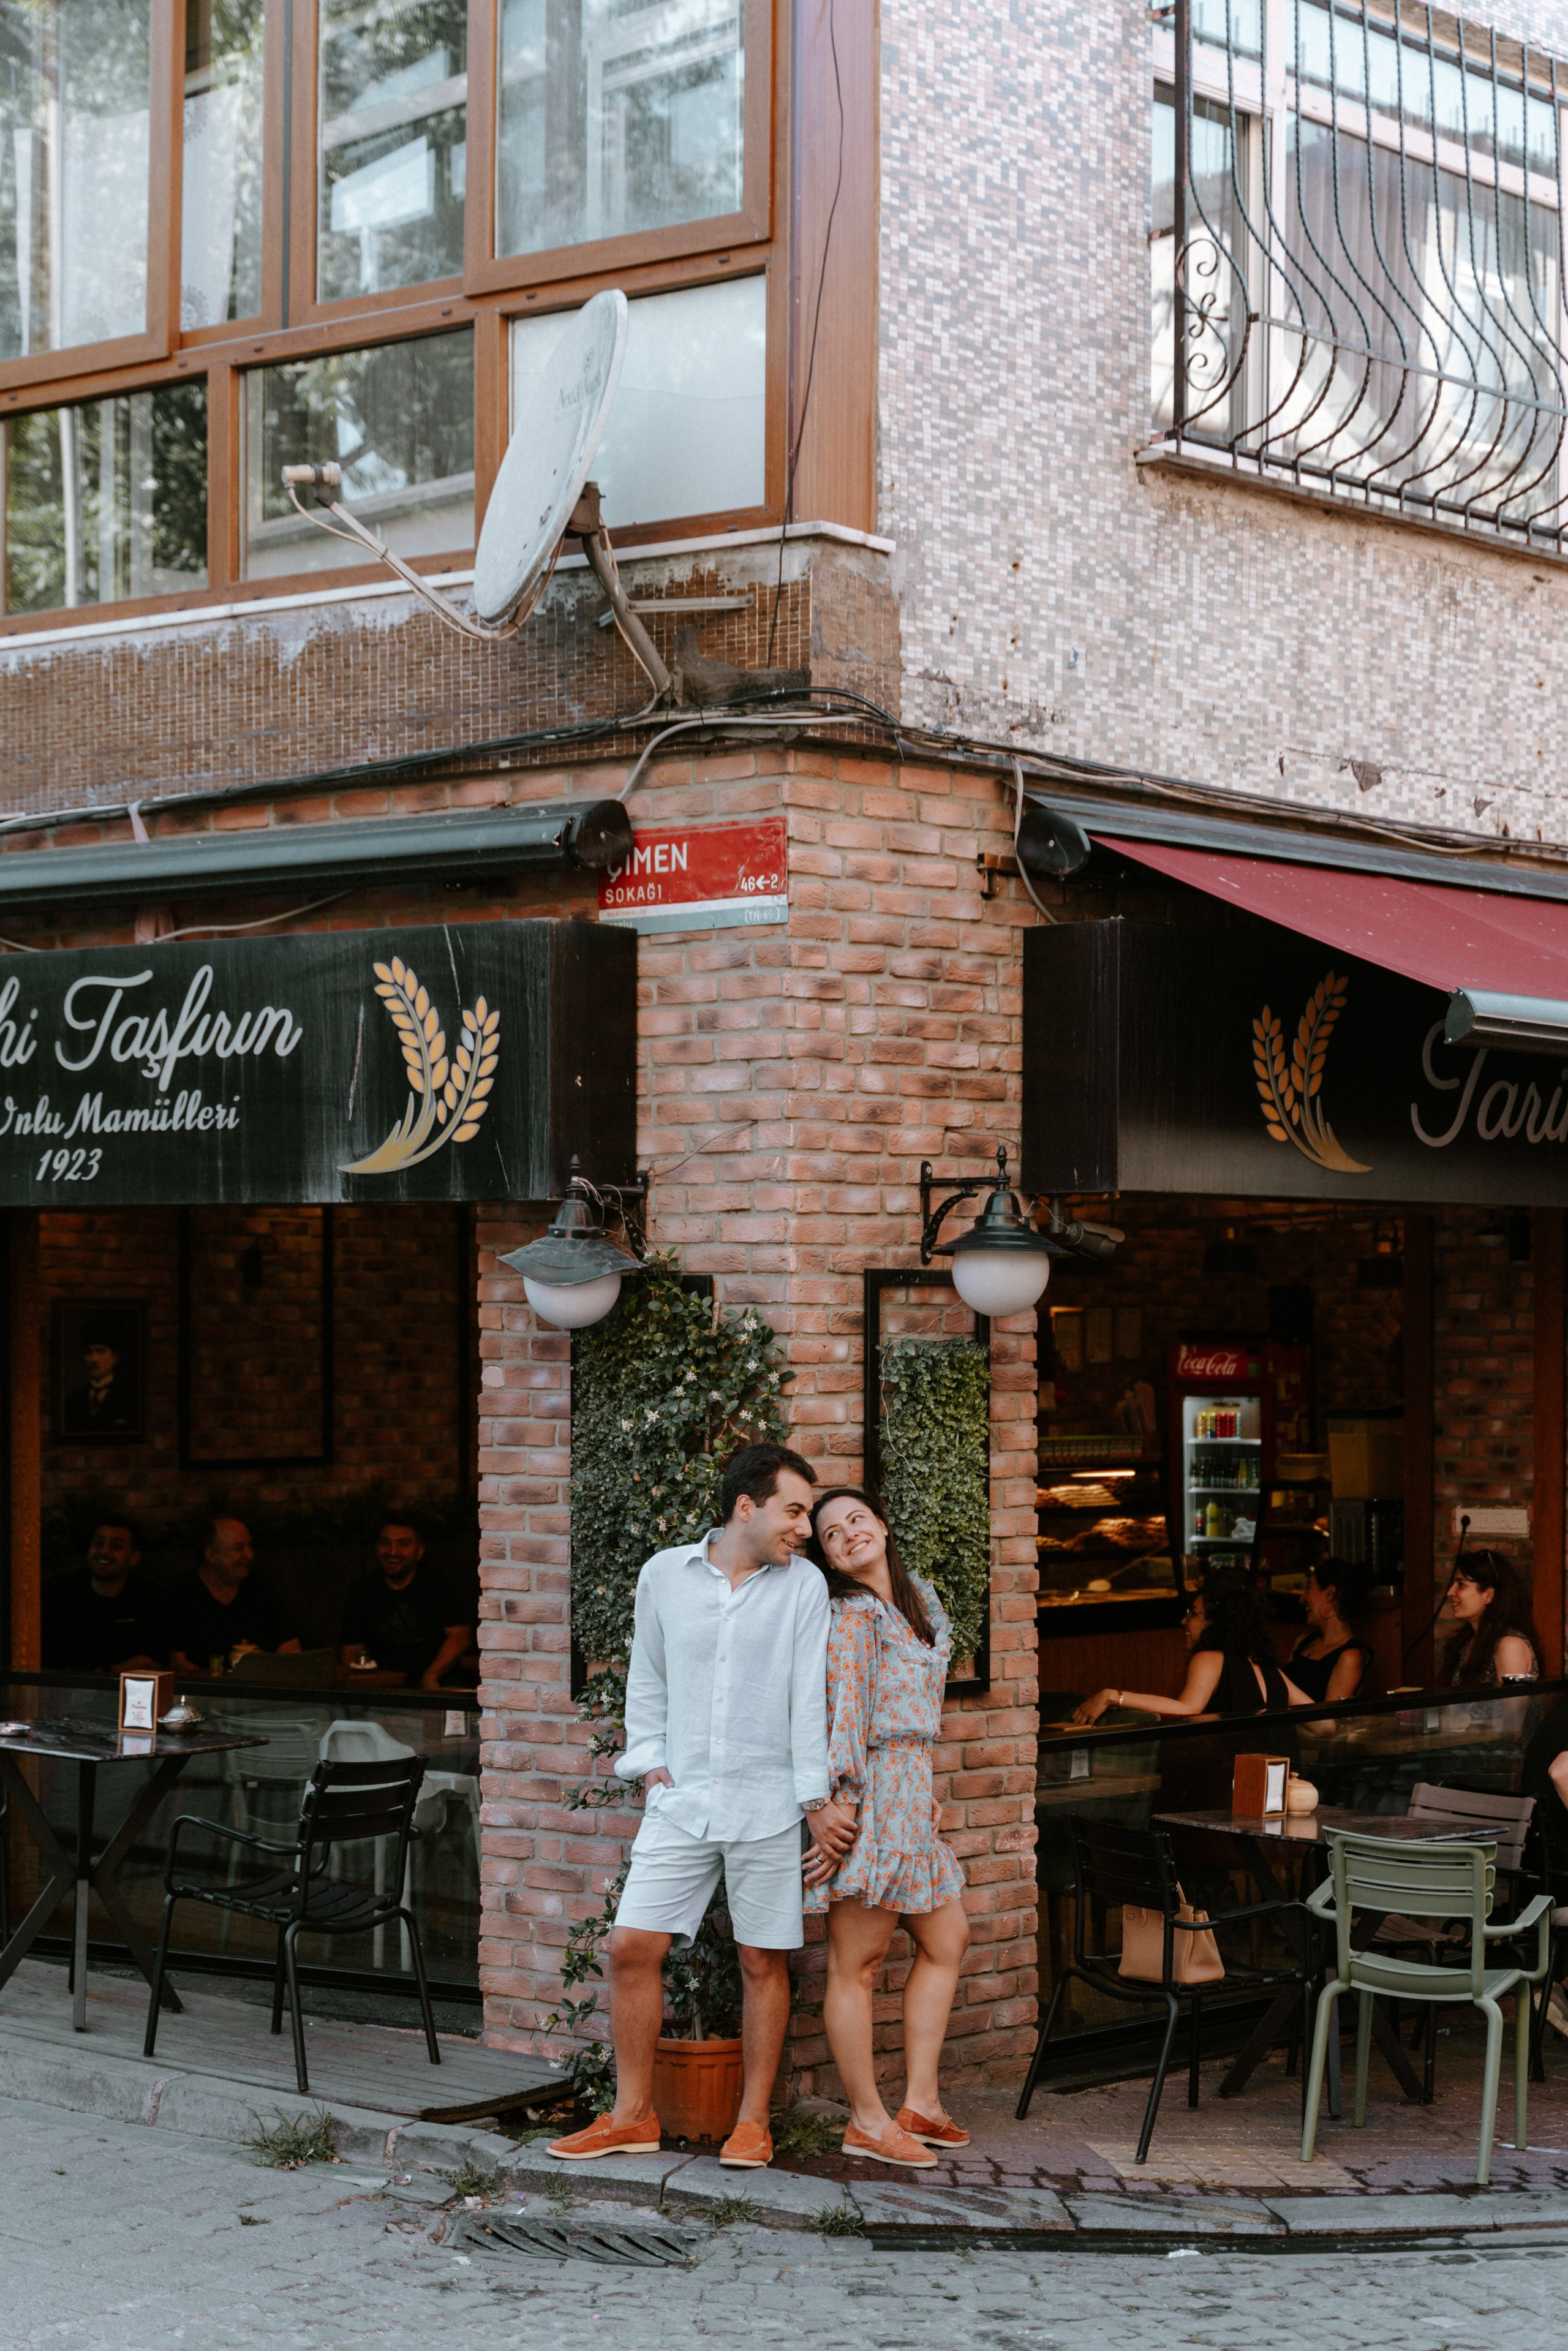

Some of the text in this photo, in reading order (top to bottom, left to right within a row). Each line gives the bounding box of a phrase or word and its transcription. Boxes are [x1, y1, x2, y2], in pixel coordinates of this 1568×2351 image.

[606, 883, 662, 904] SOKAĞI
[56, 965, 303, 1092] Taşfırın
[1411, 1019, 1568, 1147] Tari
[65, 1090, 240, 1140] Mamülleri
[36, 1149, 103, 1182] 1923
